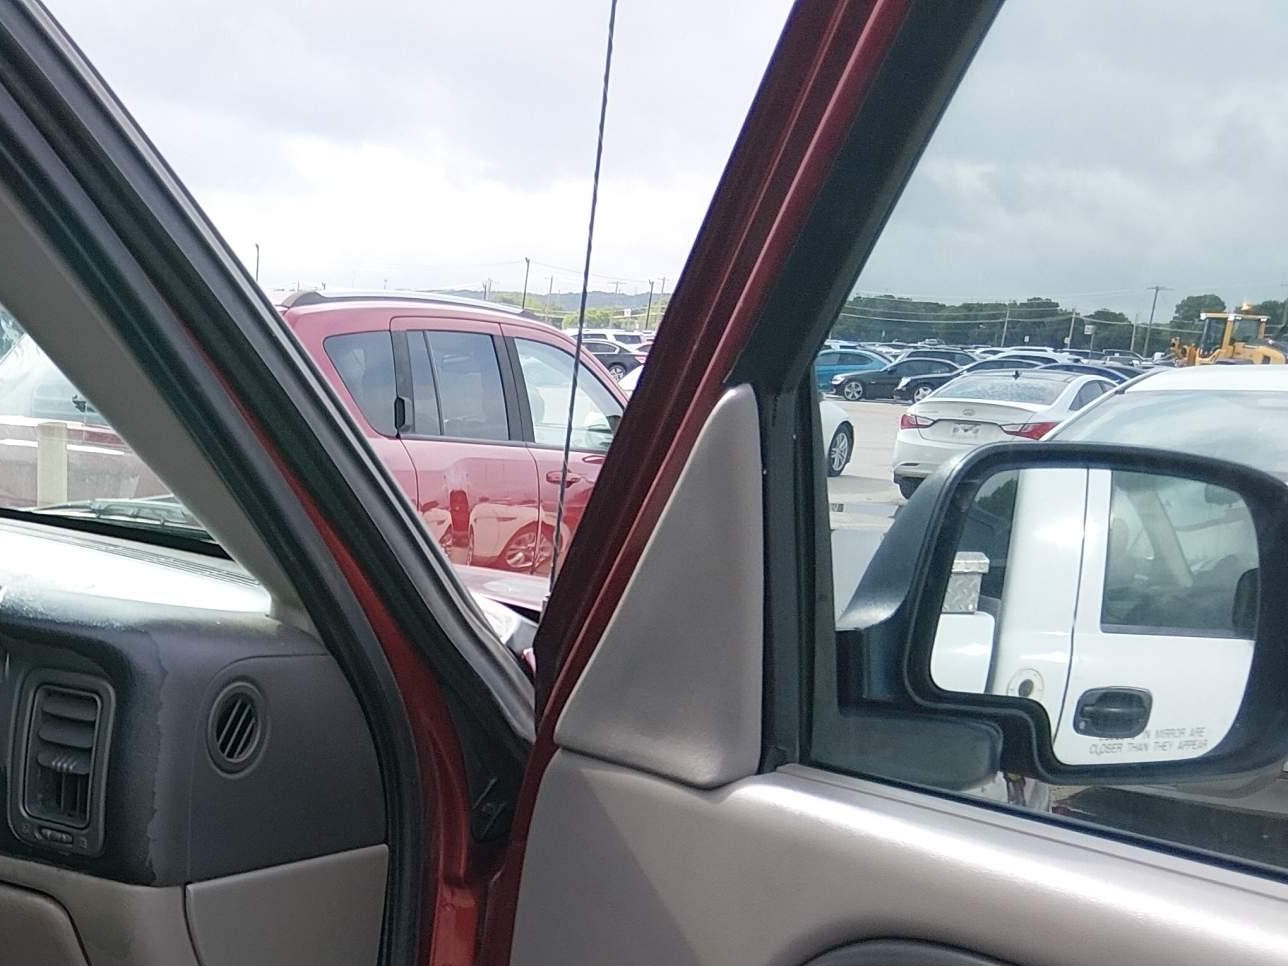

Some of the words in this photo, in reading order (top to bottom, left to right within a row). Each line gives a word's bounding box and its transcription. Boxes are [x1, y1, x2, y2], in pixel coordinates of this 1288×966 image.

[1155, 727, 1187, 739] MIRROR
[1189, 726, 1207, 738] ARE
[1088, 742, 1123, 756] CLOSER
[1127, 741, 1149, 753] THAN
[1152, 740, 1173, 752] THEY
[1177, 738, 1209, 751] APPEAR
